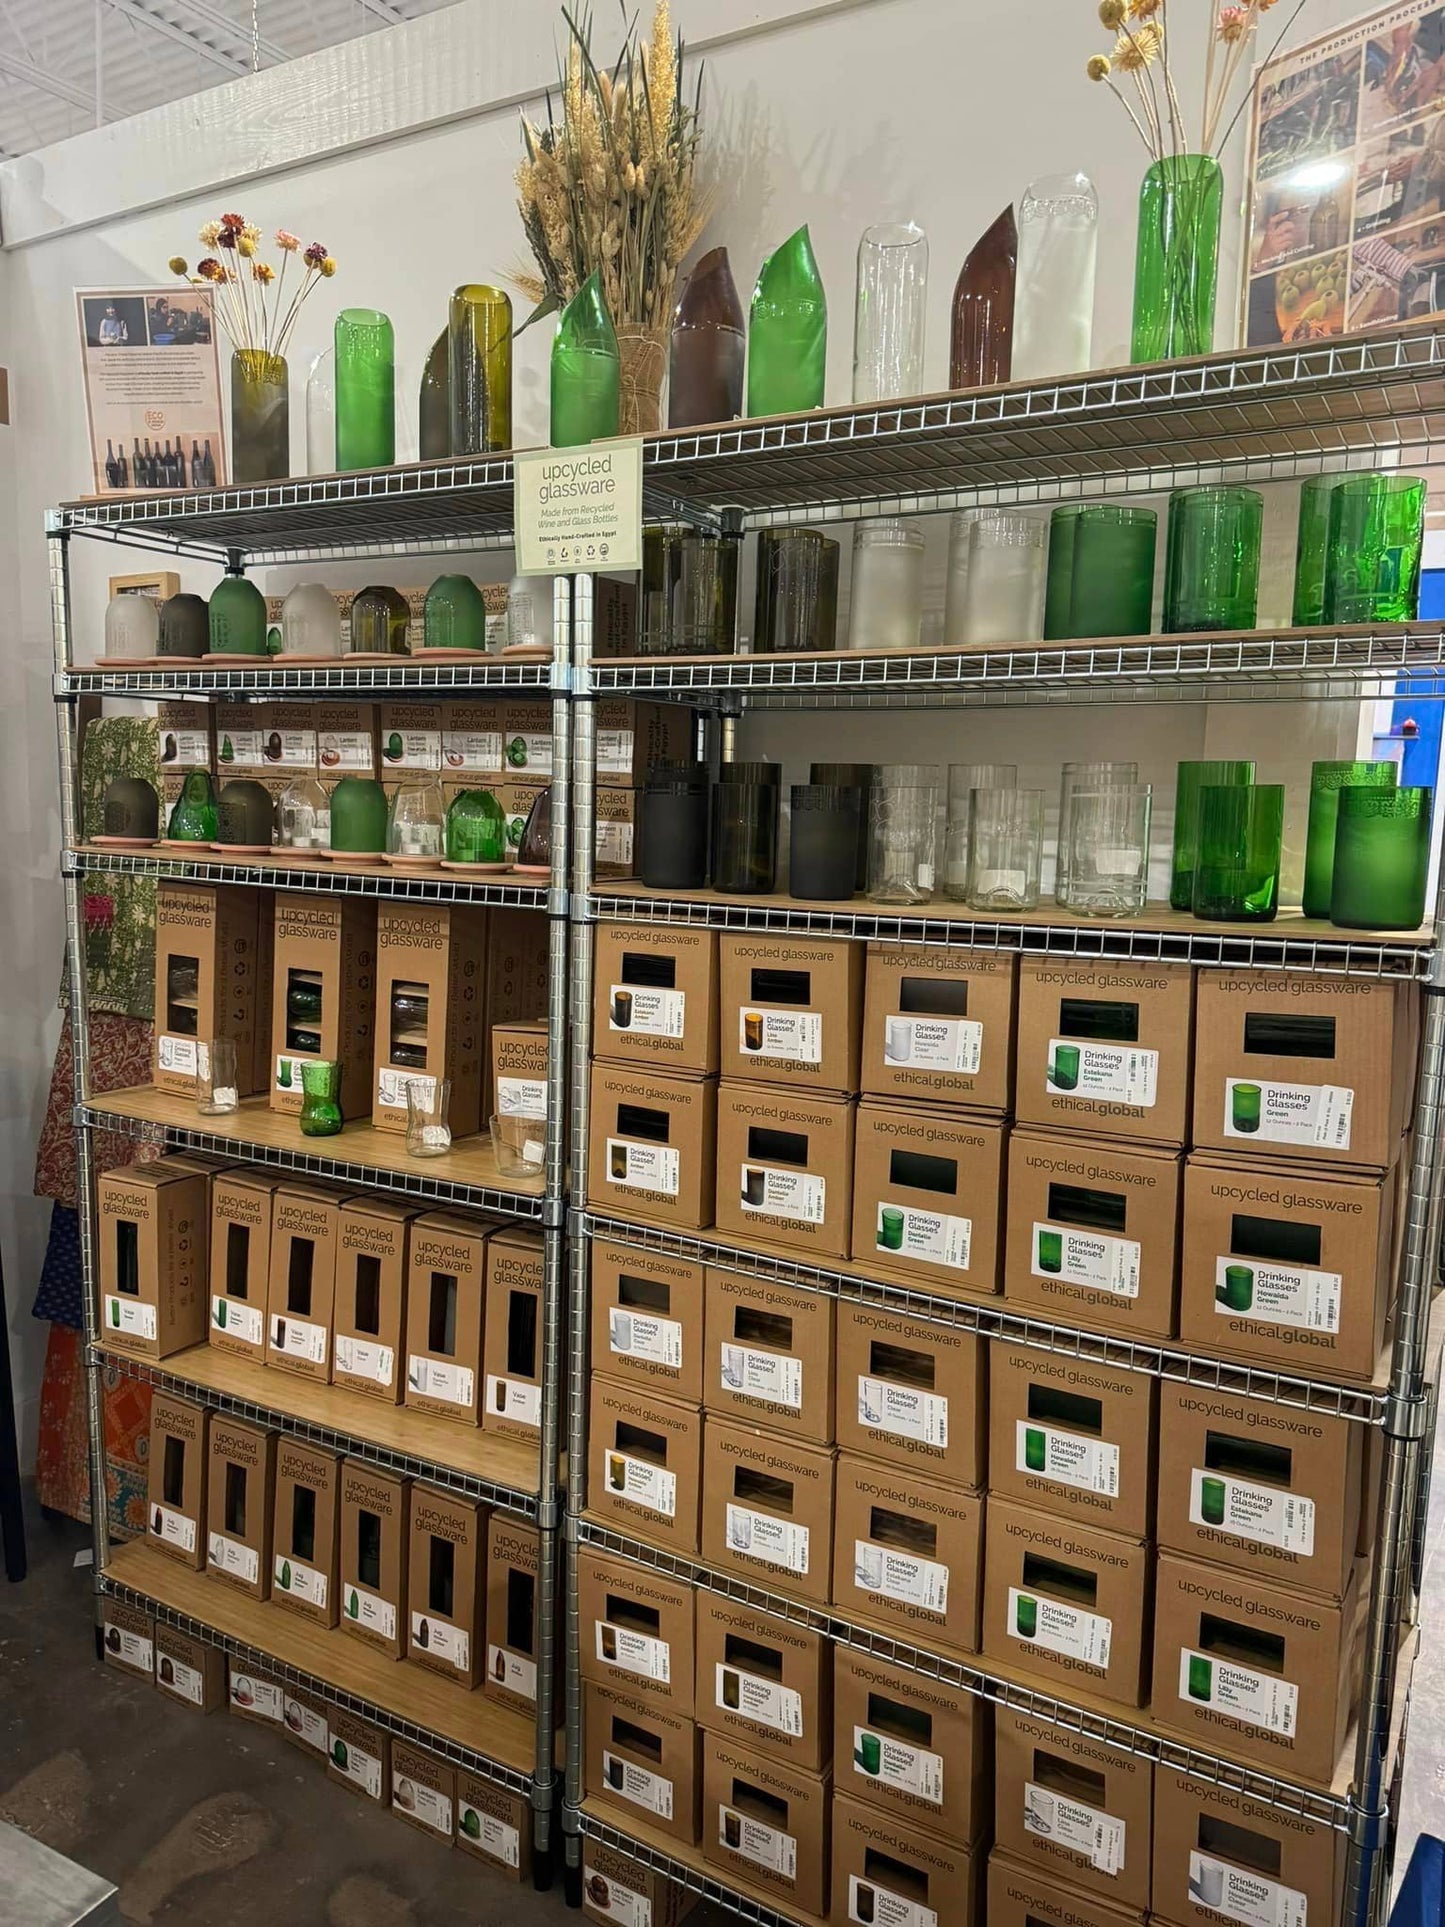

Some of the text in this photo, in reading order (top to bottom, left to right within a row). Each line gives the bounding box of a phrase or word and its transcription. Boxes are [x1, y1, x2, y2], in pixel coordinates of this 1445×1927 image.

[1300, 0, 1436, 64] THE PRODUCTION PROCESS
[542, 454, 612, 481] upcycled
[539, 478, 615, 504] glassware
[541, 502, 615, 518] Made from Recycled
[538, 514, 618, 528] Wine and Glass Bottles
[562, 532, 594, 540] Hand-Crafted
[273, 707, 311, 718] upcycled
[320, 708, 358, 720] upcycled
[392, 706, 434, 718] upcycled
[452, 707, 496, 720] upcycled
[271, 719, 313, 729] glassware
[319, 720, 361, 732] glassware
[390, 718, 436, 730] glassware
[451, 719, 498, 731] glassware
[162, 898, 210, 915] upcycled
[159, 912, 212, 928] glassware
[282, 908, 335, 926] upcycled
[383, 917, 440, 935] upcycled
[278, 923, 337, 941] glassware
[380, 933, 443, 949] glassware
[1036, 972, 1168, 989] upcycled glassware
[1219, 978, 1372, 996] upcycled glassware
[916, 1032, 946, 1041] Glasses
[1084, 1059, 1120, 1070] Glasses
[1085, 1050, 1122, 1063] Drinking
[894, 1072, 975, 1090] ethical.global
[1084, 1069, 1113, 1078] Estekana
[1084, 1074, 1102, 1082] Green
[605, 1080, 692, 1104] upcycled glassware
[1267, 1089, 1311, 1103] Drinking
[732, 1102, 832, 1126] upcycled glassware
[1052, 1098, 1145, 1118] ethical.global
[1267, 1099, 1308, 1112] Glasses
[1267, 1109, 1289, 1118] Green
[873, 1121, 985, 1147] upcycled glassware
[1026, 1156, 1157, 1187] upcycled glassware
[104, 1190, 147, 1206] upcycled
[218, 1193, 260, 1211] upcycled
[1211, 1184, 1363, 1214] upcycled glassware
[103, 1202, 149, 1219] glassware
[216, 1205, 262, 1224] glassware
[280, 1205, 327, 1223] upcycled
[277, 1218, 329, 1236] glassware
[908, 1214, 941, 1228] Drinking
[345, 1223, 393, 1243] upcycled
[343, 1235, 395, 1256] glassware
[418, 1240, 470, 1260] upcycled
[1068, 1237, 1105, 1253] Drinking
[1068, 1246, 1103, 1259] Glasses
[415, 1253, 472, 1273] glassware
[606, 1252, 692, 1278] upcycled glassware
[1068, 1261, 1086, 1269] Green
[1258, 1271, 1301, 1286] Drinking
[1258, 1280, 1298, 1293] Glasses
[720, 1281, 817, 1312] upcycled glassware
[1041, 1281, 1133, 1310] ethical.global
[1257, 1290, 1289, 1300] Howaida
[1257, 1296, 1279, 1305] Green
[853, 1313, 962, 1348] upcycled glassware
[1229, 1320, 1337, 1349] ethical.global
[1009, 1356, 1133, 1396] upcycled glassware
[512, 1391, 526, 1399] Vase
[157, 1407, 195, 1428] upcycled
[603, 1397, 688, 1432] upcycled glassware
[1179, 1398, 1323, 1438] upcycled glassware
[154, 1417, 196, 1440] glassware
[216, 1431, 257, 1454] upcycled
[868, 1429, 946, 1460] ethical.global
[1051, 1436, 1087, 1453] Drinking
[213, 1442, 258, 1465] glassware
[720, 1441, 819, 1479] upcycled glassware
[283, 1454, 326, 1476] upcycled
[1051, 1460, 1069, 1469] Green
[281, 1464, 328, 1489] glassware
[347, 1479, 390, 1502] upcycled
[855, 1480, 967, 1520] upcycled glassware
[1025, 1477, 1113, 1512] ethical.global
[1231, 1487, 1273, 1505] Drinking
[345, 1491, 393, 1515] glassware
[1230, 1506, 1262, 1519] Estekana
[1231, 1496, 1270, 1512] Glasses
[418, 1506, 466, 1531] upcycled
[1230, 1511, 1252, 1522] Green
[415, 1518, 468, 1544] glassware
[1005, 1523, 1129, 1569] upcycled glassware
[1196, 1528, 1300, 1564] ethical.global
[886, 1556, 919, 1573] Drinking
[868, 1593, 947, 1627] ethical.global
[1042, 1604, 1078, 1623] Drinking
[1178, 1580, 1321, 1631] upcycled glassware
[1041, 1621, 1060, 1630] Green
[1019, 1642, 1107, 1680] ethical.global
[1219, 1667, 1260, 1688] Drinking
[1219, 1676, 1257, 1694] Glasses
[851, 1665, 958, 1711] upcycled glassware
[1218, 1690, 1239, 1701] Green
[1194, 1708, 1295, 1750] ethical.global
[1015, 1719, 1136, 1772] upcycled glassware
[467, 1780, 511, 1812] upcycled
[466, 1792, 514, 1824] glassware
[1057, 1802, 1093, 1822] Drinking
[1176, 1779, 1315, 1835] upcycled glassware
[848, 1818, 955, 1873] upcycled glassware
[1228, 1882, 1266, 1901] Glasses
[1229, 1873, 1269, 1896] Drinking
